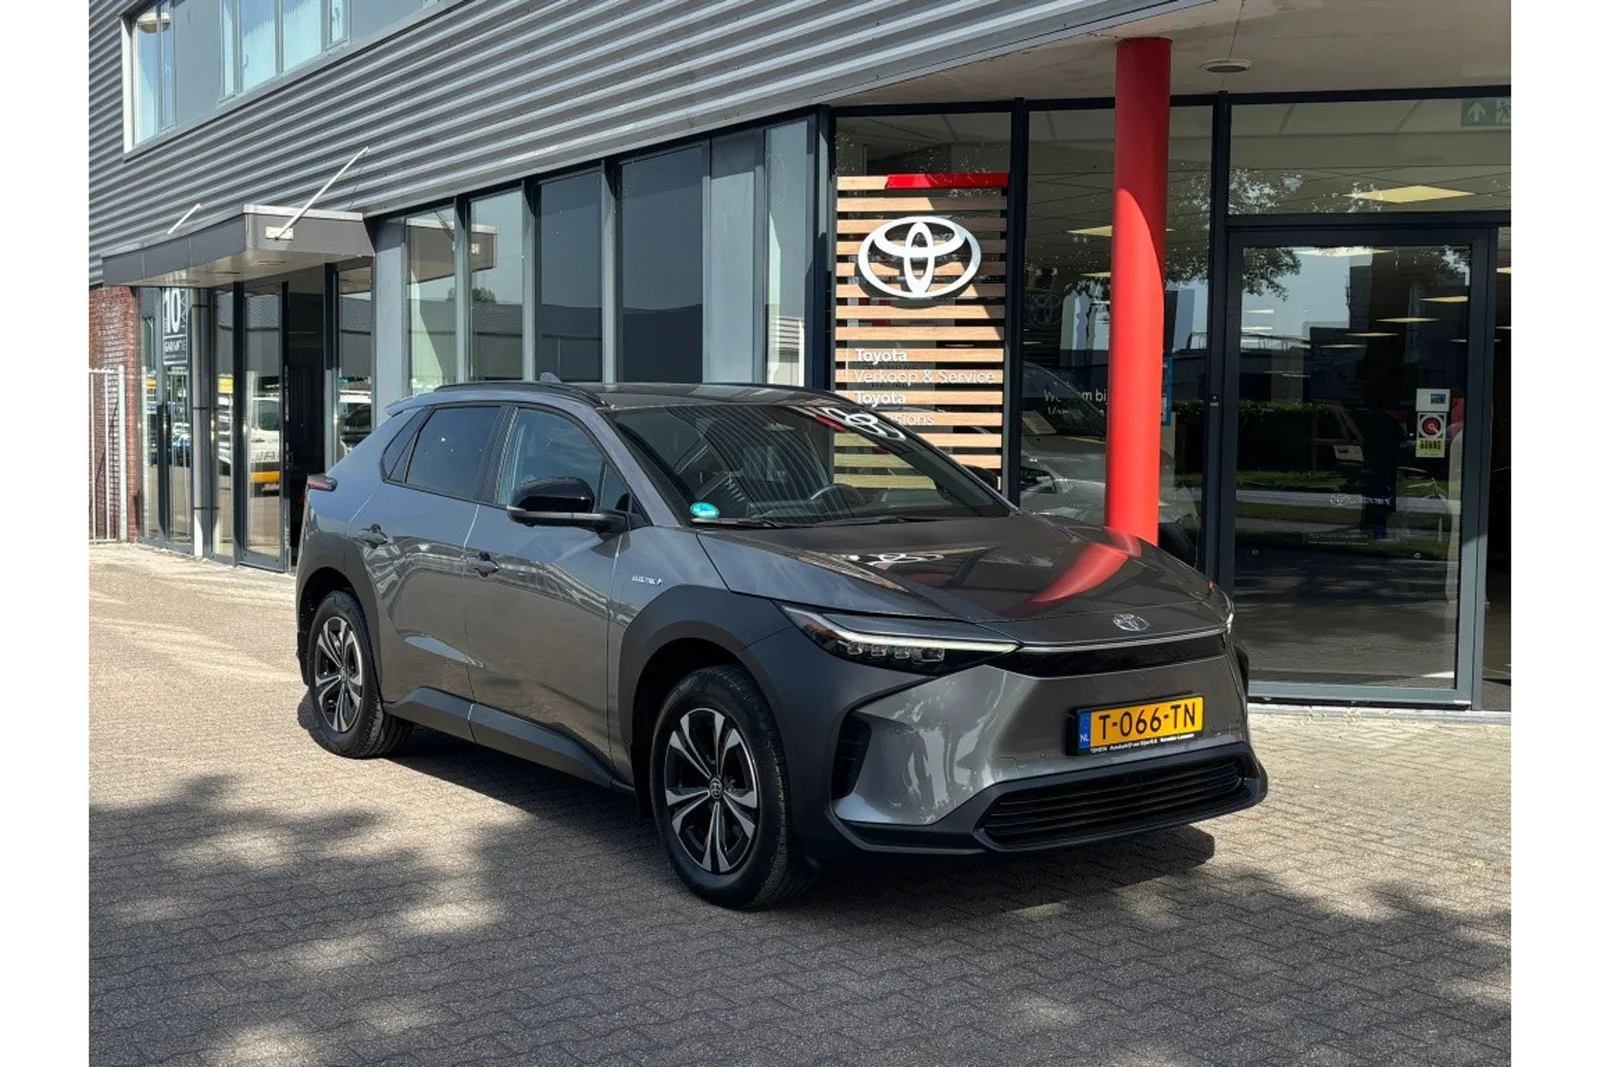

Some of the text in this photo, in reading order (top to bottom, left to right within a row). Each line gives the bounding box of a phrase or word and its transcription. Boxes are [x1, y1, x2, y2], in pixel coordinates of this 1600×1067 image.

[855, 349, 908, 365] Toyota
[854, 370, 919, 386] Verkoop
[923, 371, 933, 383] &
[938, 370, 995, 384] Service
[855, 392, 907, 408] Toyota
[889, 413, 935, 426] sions
[1098, 701, 1197, 740] T-066-TN
[1080, 734, 1089, 744] NL
